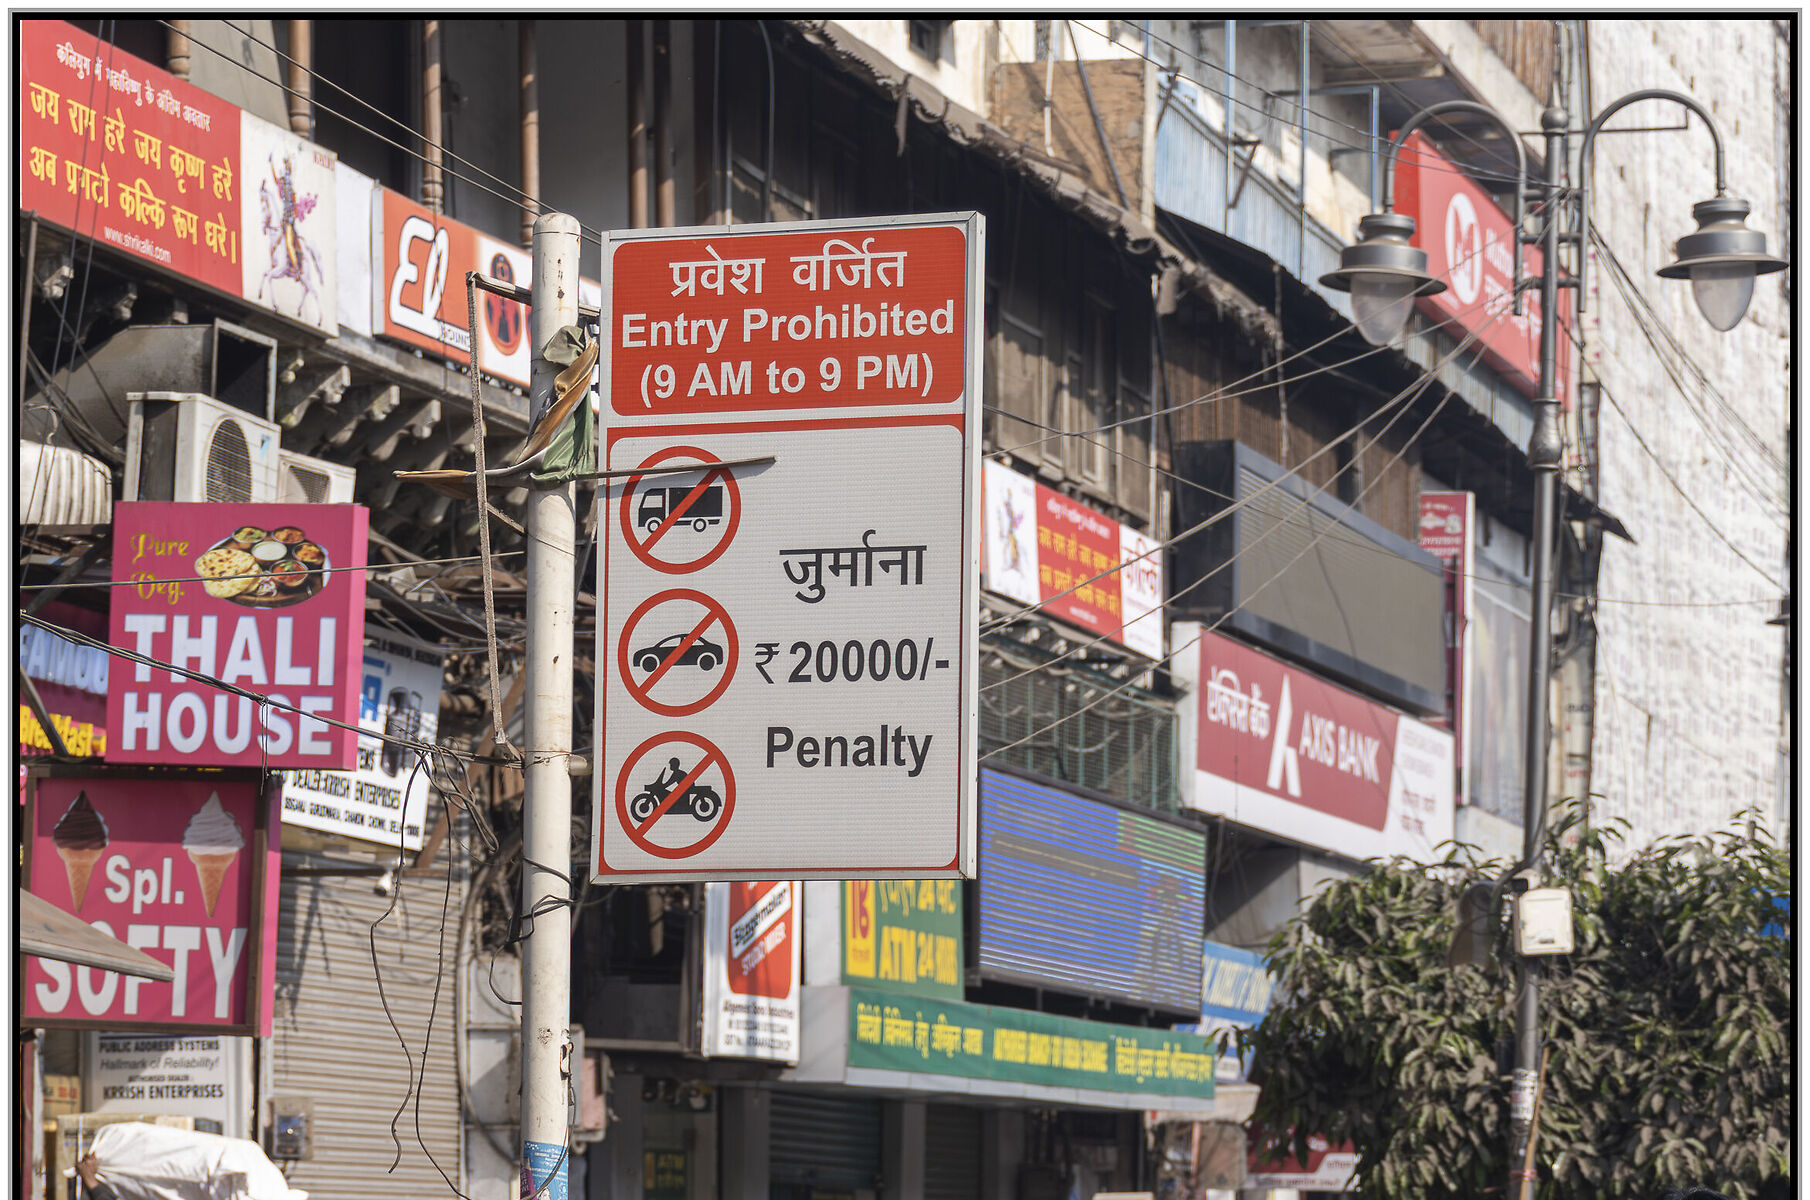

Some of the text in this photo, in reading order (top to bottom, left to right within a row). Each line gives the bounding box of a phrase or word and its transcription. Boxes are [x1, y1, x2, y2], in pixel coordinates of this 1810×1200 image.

[29, 82, 233, 201] जय राम हरे जय कृष्ण हरे
[29, 146, 58, 186] अब
[65, 161, 110, 208] प्रगटो
[117, 177, 166, 230] कल्कि
[171, 205, 199, 245] रूप
[669, 237, 908, 298] प्रवेश वर्जित
[622, 300, 955, 353] Entry Prohibited
[640, 353, 934, 408] (9 AM to 9 PM)
[131, 532, 189, 565] Pure
[779, 529, 927, 603] जुर्माना
[131, 571, 185, 605] Veg.
[124, 614, 336, 686] THALI
[788, 637, 950, 684] 20000/-
[121, 691, 333, 755] HOUSE
[766, 724, 934, 778] Penalty
[1299, 711, 1336, 767] AXIS
[1338, 725, 1380, 784] BANK
[105, 855, 184, 914] Spl.
[879, 926, 917, 984] ATM
[917, 931, 935, 979] 24
[100, 1041, 131, 1053] PUBLIC
[101, 1058, 147, 1070] Hallmark
[150, 1057, 161, 1069] of
[103, 1085, 223, 1099] KRRISH ENTERPRISES
